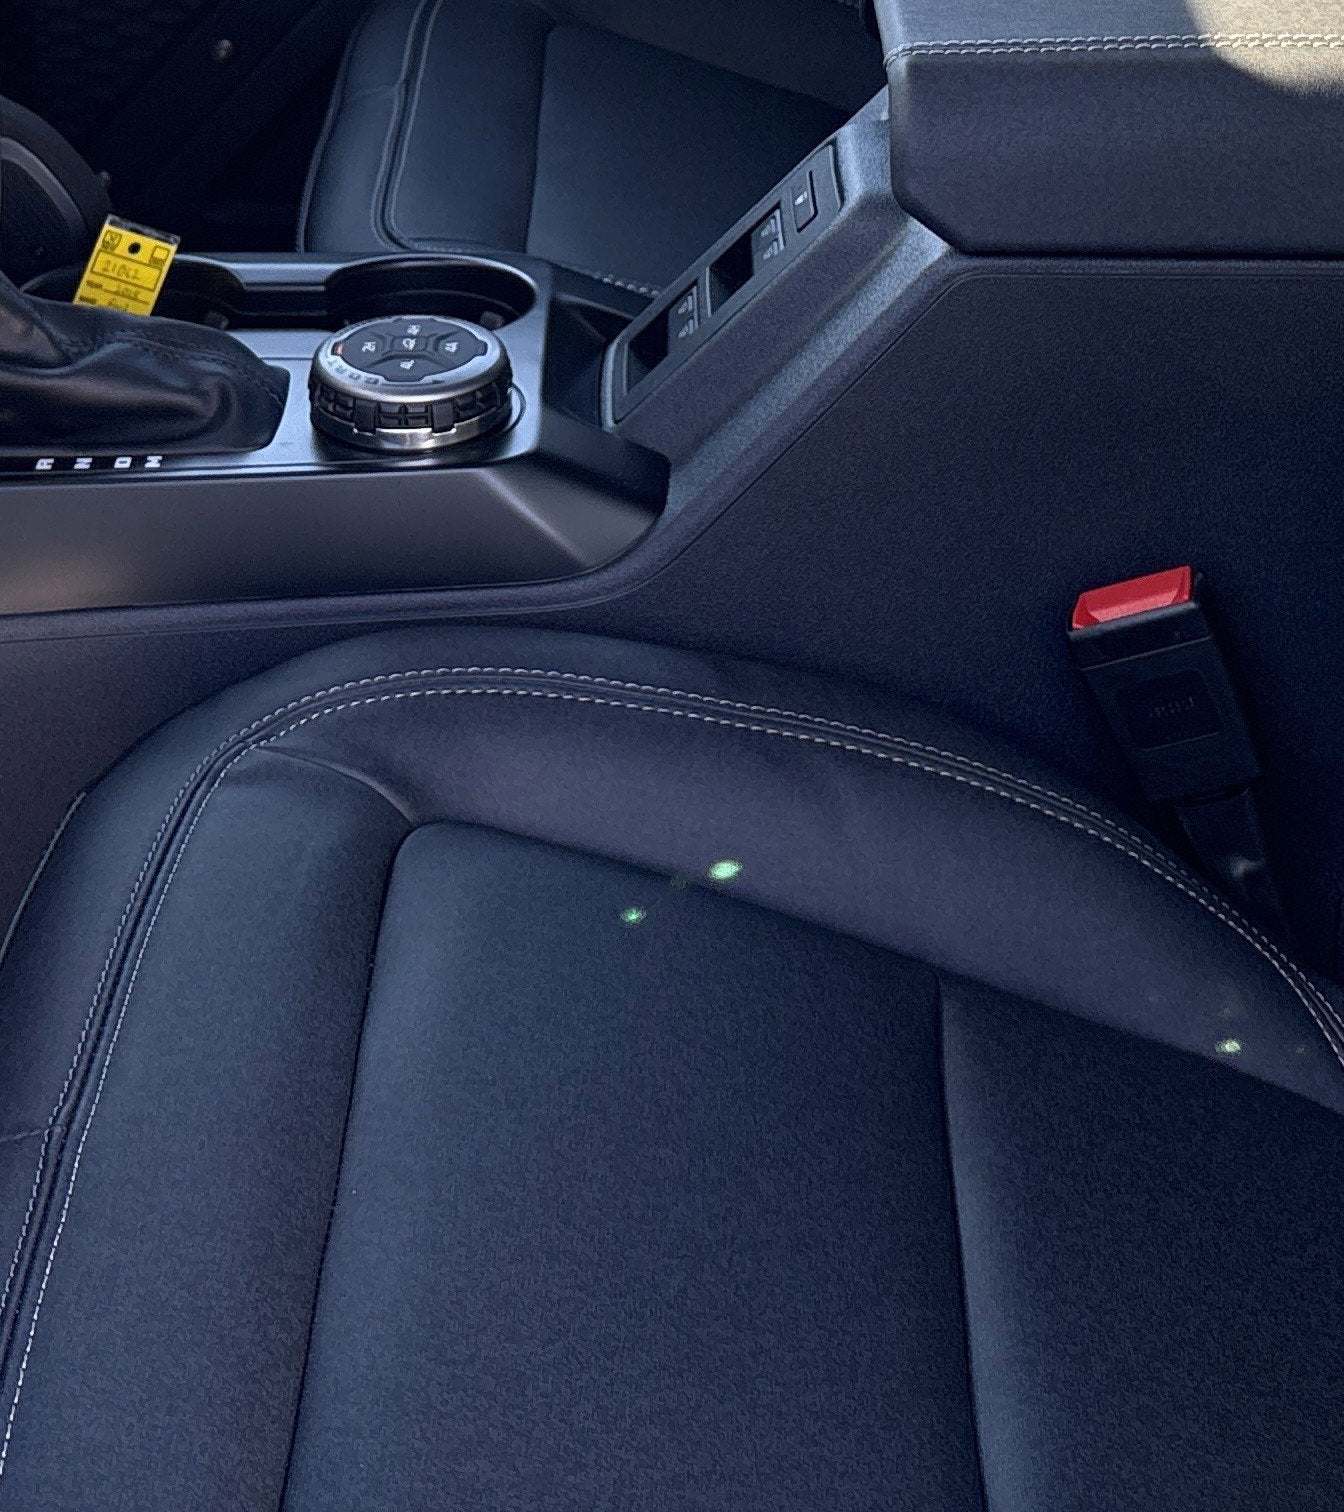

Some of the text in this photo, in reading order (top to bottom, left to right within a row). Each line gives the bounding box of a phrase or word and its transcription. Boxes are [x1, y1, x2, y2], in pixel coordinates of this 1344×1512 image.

[35, 457, 55, 471] R
[73, 457, 93, 470] N
[113, 456, 133, 469] D
